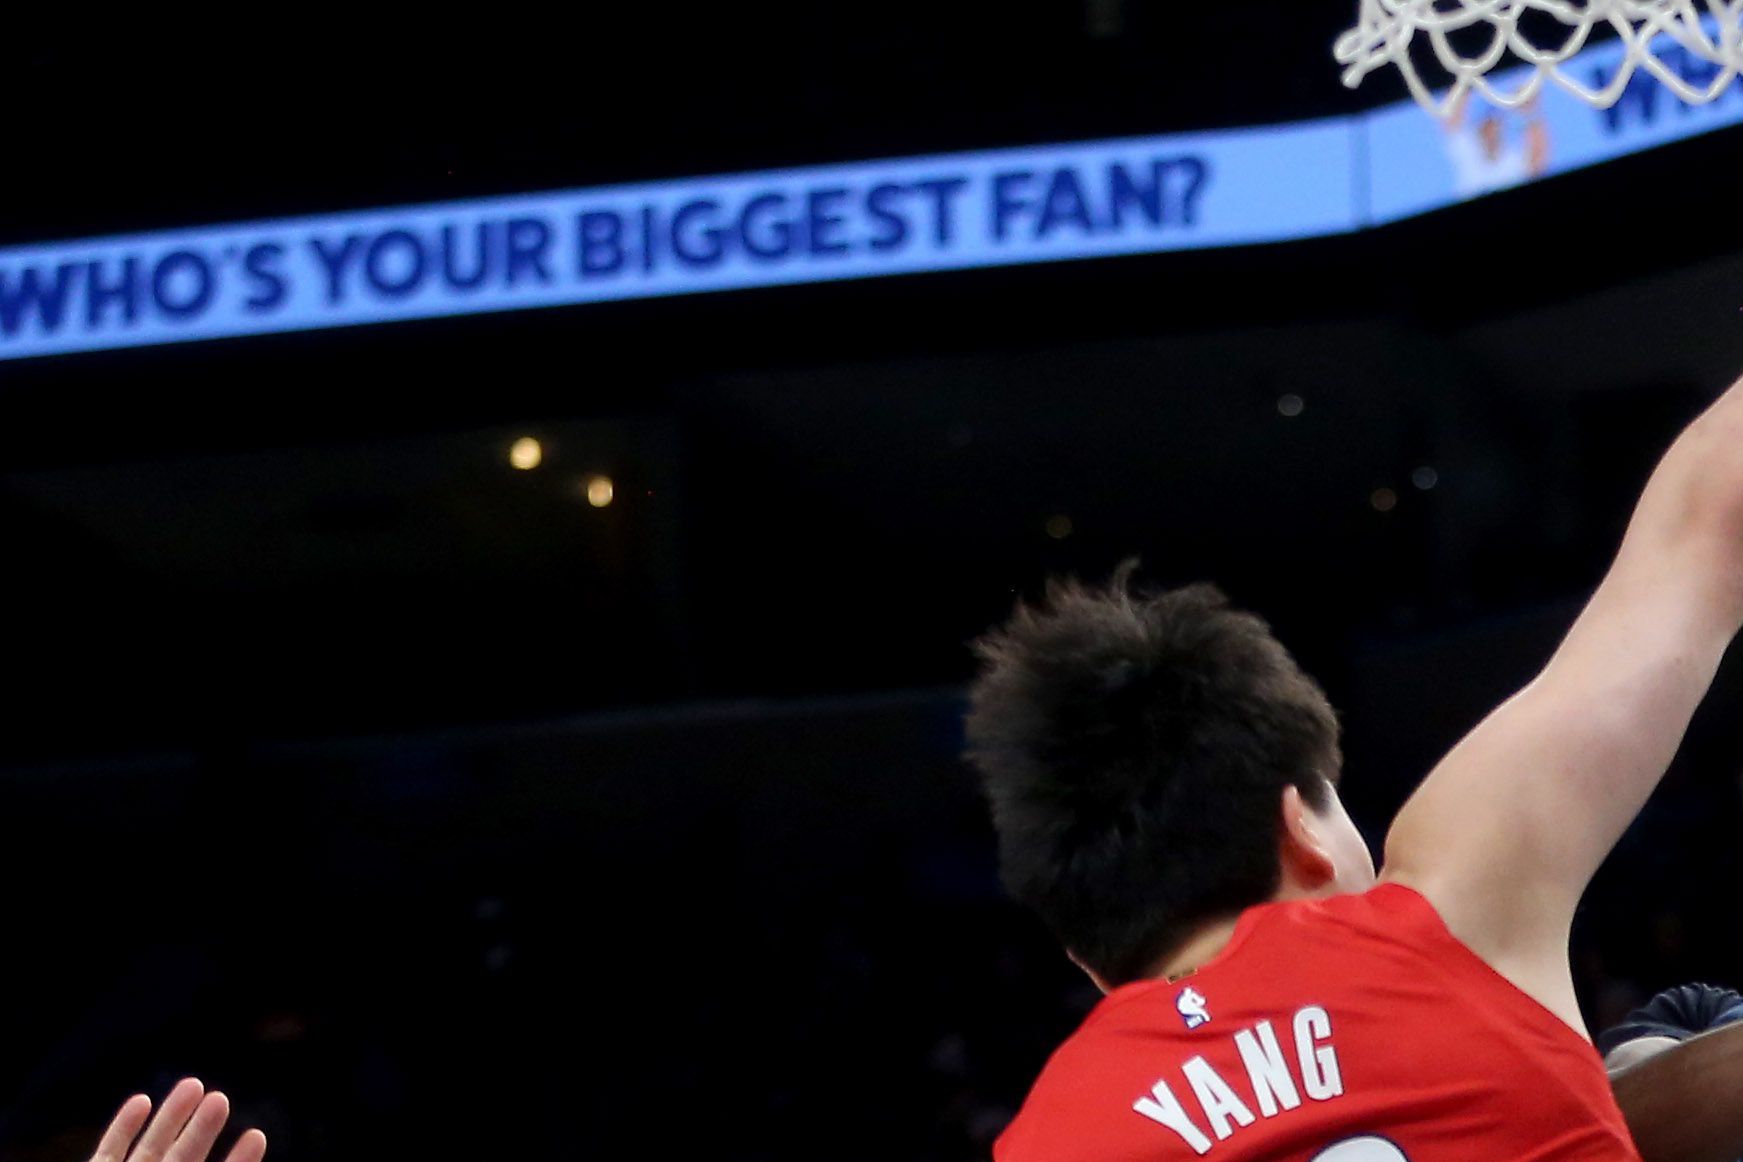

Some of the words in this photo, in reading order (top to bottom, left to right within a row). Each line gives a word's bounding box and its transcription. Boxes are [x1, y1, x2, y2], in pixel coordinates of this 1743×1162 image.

[0, 240, 288, 337] WHO'S
[311, 217, 551, 304] YOUR
[577, 174, 967, 280] BIGGEST
[987, 155, 1213, 244] FAN?
[1132, 1004, 1345, 1155] YANG
